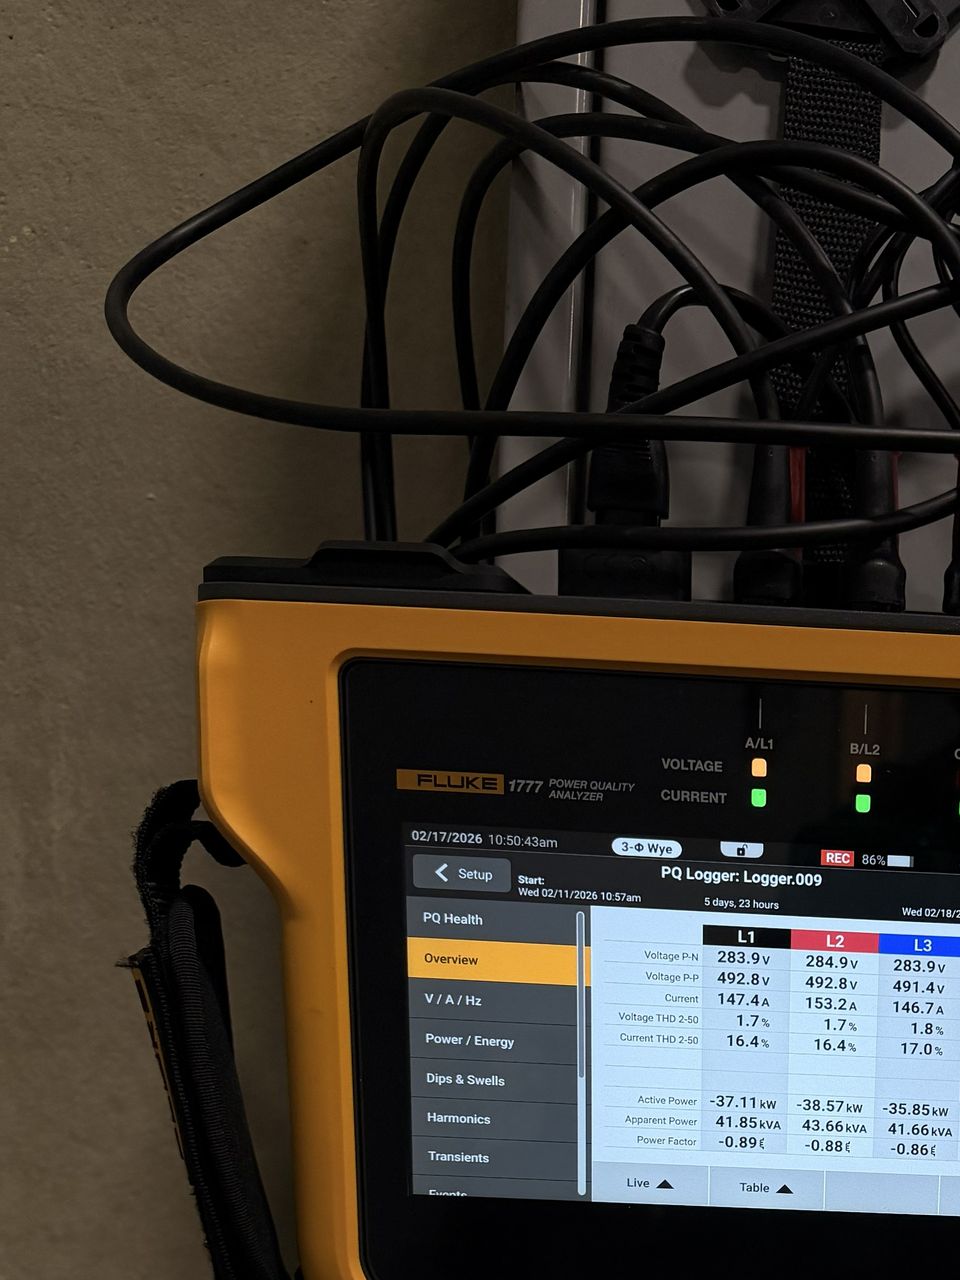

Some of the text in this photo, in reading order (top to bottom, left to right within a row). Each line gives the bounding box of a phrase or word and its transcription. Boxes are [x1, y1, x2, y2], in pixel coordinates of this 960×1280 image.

[745, 738, 774, 751] A/L1
[850, 743, 880, 756] B/L2
[661, 758, 723, 772] VOLTAGE
[416, 773, 499, 790] FLUKE
[508, 779, 543, 793] 1777
[549, 779, 635, 792] POWER QUALITY
[549, 791, 603, 802] ANALYZER
[660, 789, 727, 804] CURRENT
[411, 830, 558, 848] 02/17/2026 10:50:43am
[647, 843, 673, 855] Wye
[826, 853, 850, 864] REC
[861, 854, 886, 866] 86%
[458, 868, 493, 881] Setup
[518, 875, 545, 885] Start:
[661, 866, 822, 887] PQ Logger: Logger.009
[518, 887, 642, 903] Wed 02/11/2026 10:57am
[704, 898, 779, 910] 5 days, 23 hours
[902, 907, 922, 917] Wed
[423, 912, 483, 926] PQ Health
[738, 929, 755, 944] L1
[826, 934, 844, 948] L2
[914, 939, 932, 952] L3
[424, 953, 478, 966] Overview
[644, 951, 680, 961] Voltage
[682, 953, 699, 961] P-N
[645, 972, 681, 982] Voltage
[683, 974, 699, 982] P-P
[665, 994, 699, 1003] Current
[618, 1012, 654, 1023] Voltage
[655, 1014, 676, 1023] THD
[678, 1016, 699, 1024] 2-50
[425, 1033, 515, 1050] Power Energy
[619, 1033, 654, 1043] Current
[655, 1034, 676, 1043] THD
[678, 1036, 699, 1045] 2-50
[426, 1073, 505, 1087] Dips & Swells
[638, 1095, 666, 1105] Active
[668, 1097, 698, 1106] Power
[427, 1112, 491, 1125] Harmonics
[624, 1116, 667, 1127] Apparent
[668, 1117, 698, 1126] Power
[637, 1136, 697, 1146] Power Factor
[428, 1151, 489, 1164] Transients
[627, 1178, 770, 1193] Live Table
